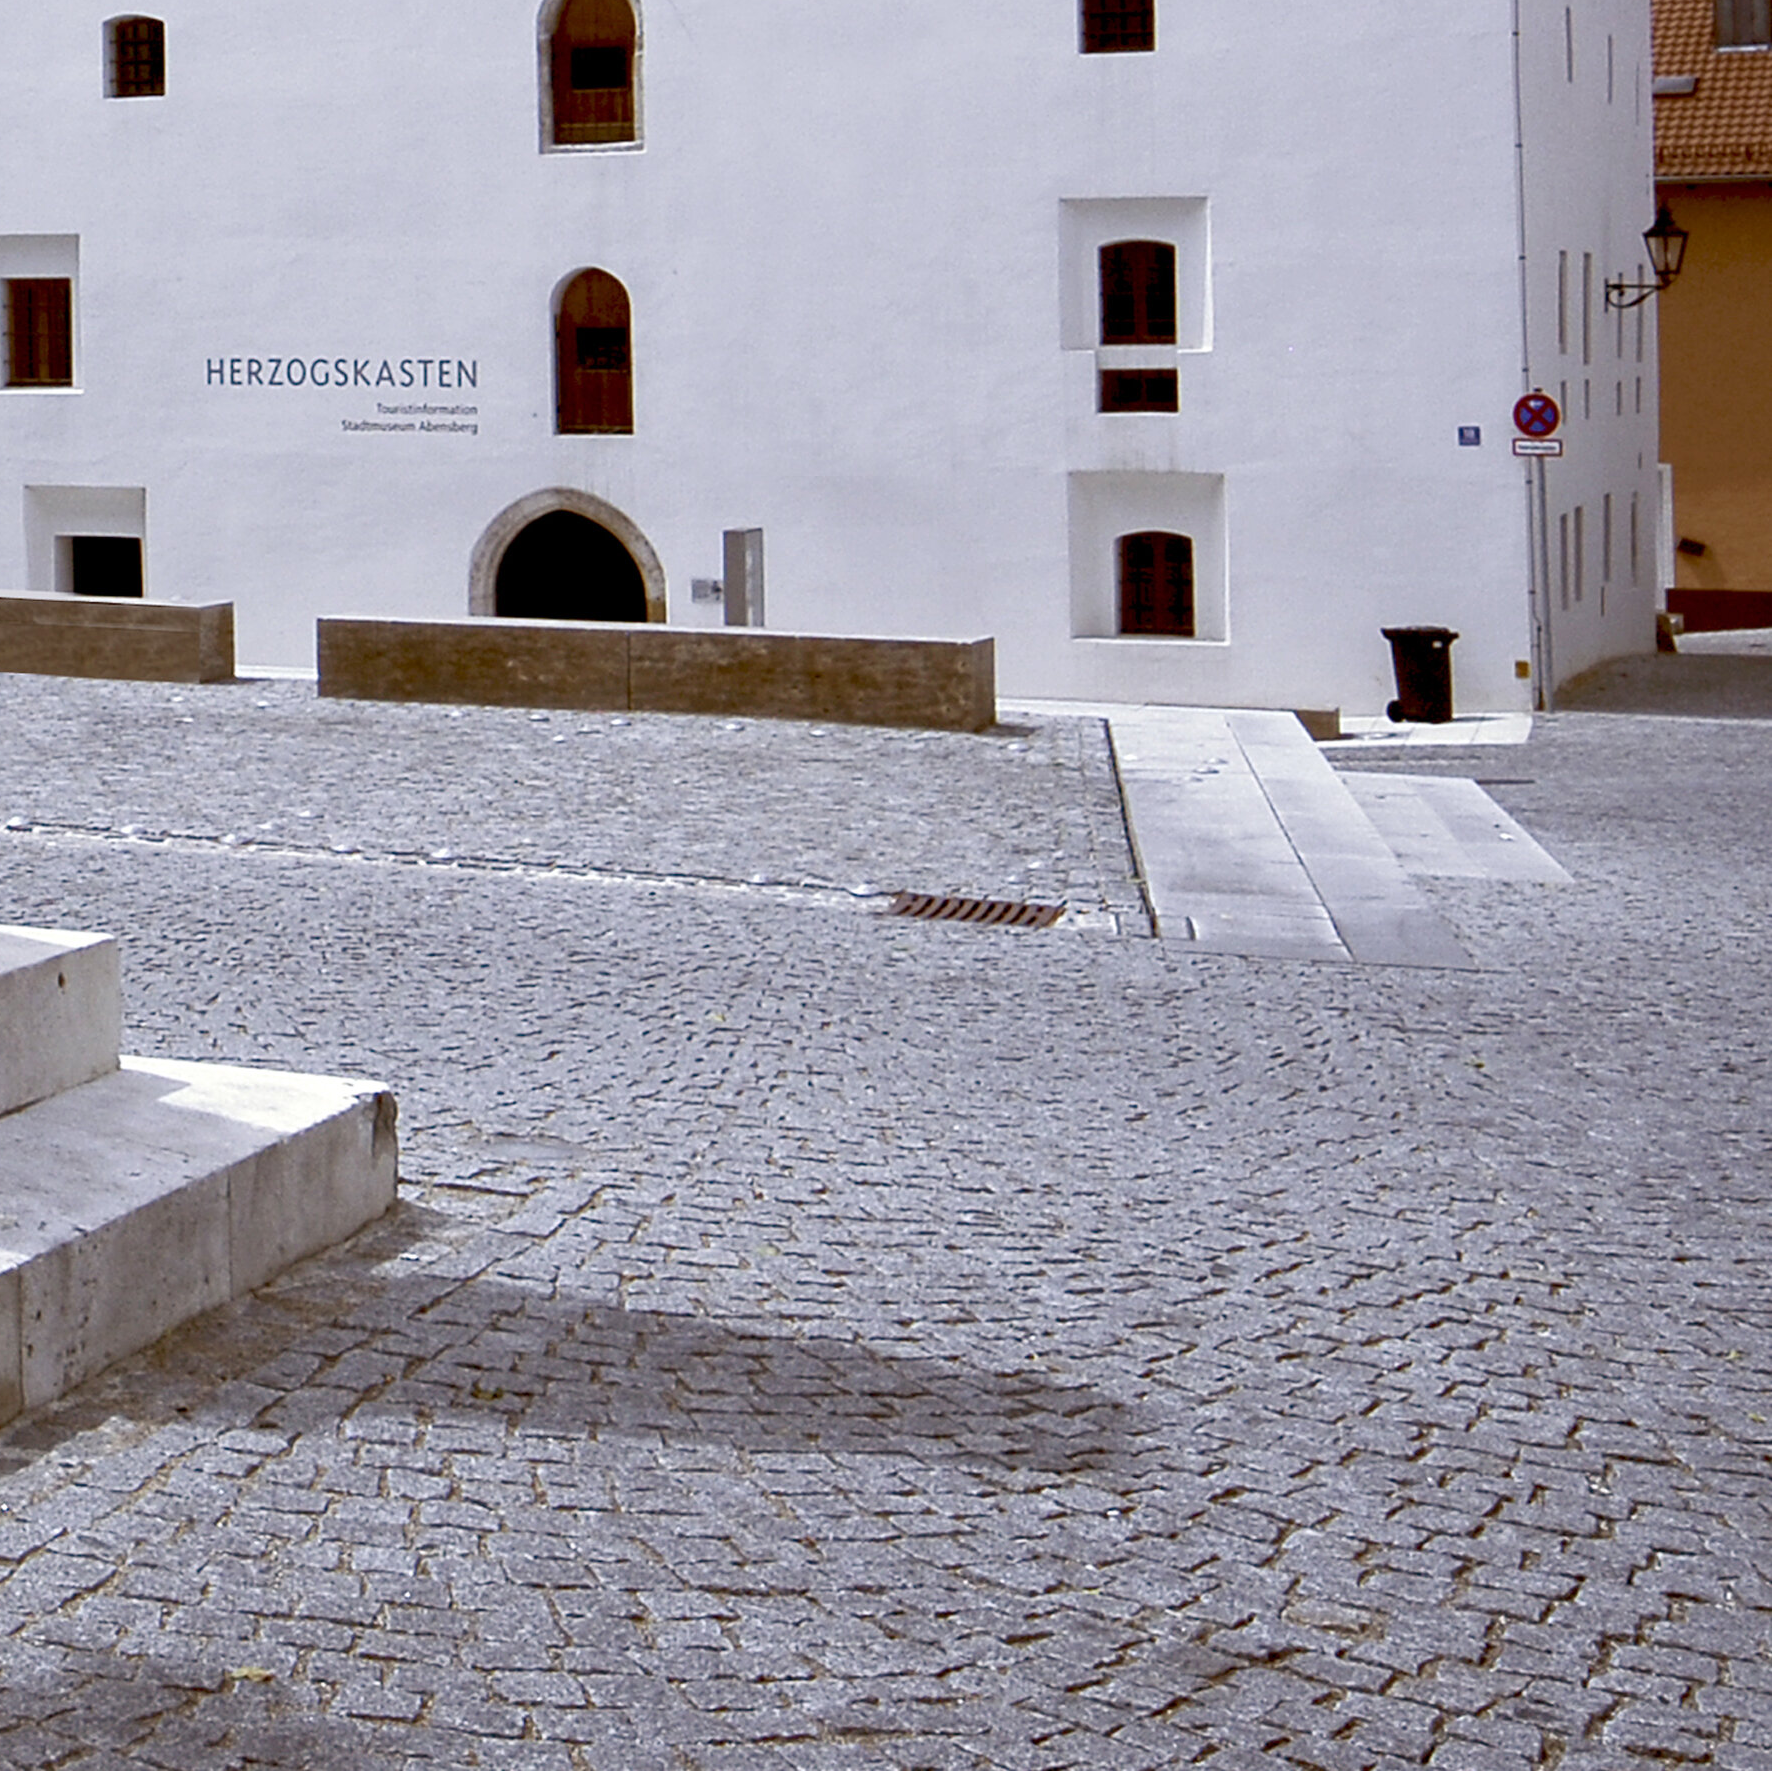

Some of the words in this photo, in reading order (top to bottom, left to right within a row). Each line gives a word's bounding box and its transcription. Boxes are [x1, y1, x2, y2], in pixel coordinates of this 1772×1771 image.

[206, 358, 478, 388] HERZOGSKASTEN
[376, 402, 478, 415] Touristinformation
[341, 419, 416, 432] Stadtmuseum
[418, 420, 478, 436] Abensberg
